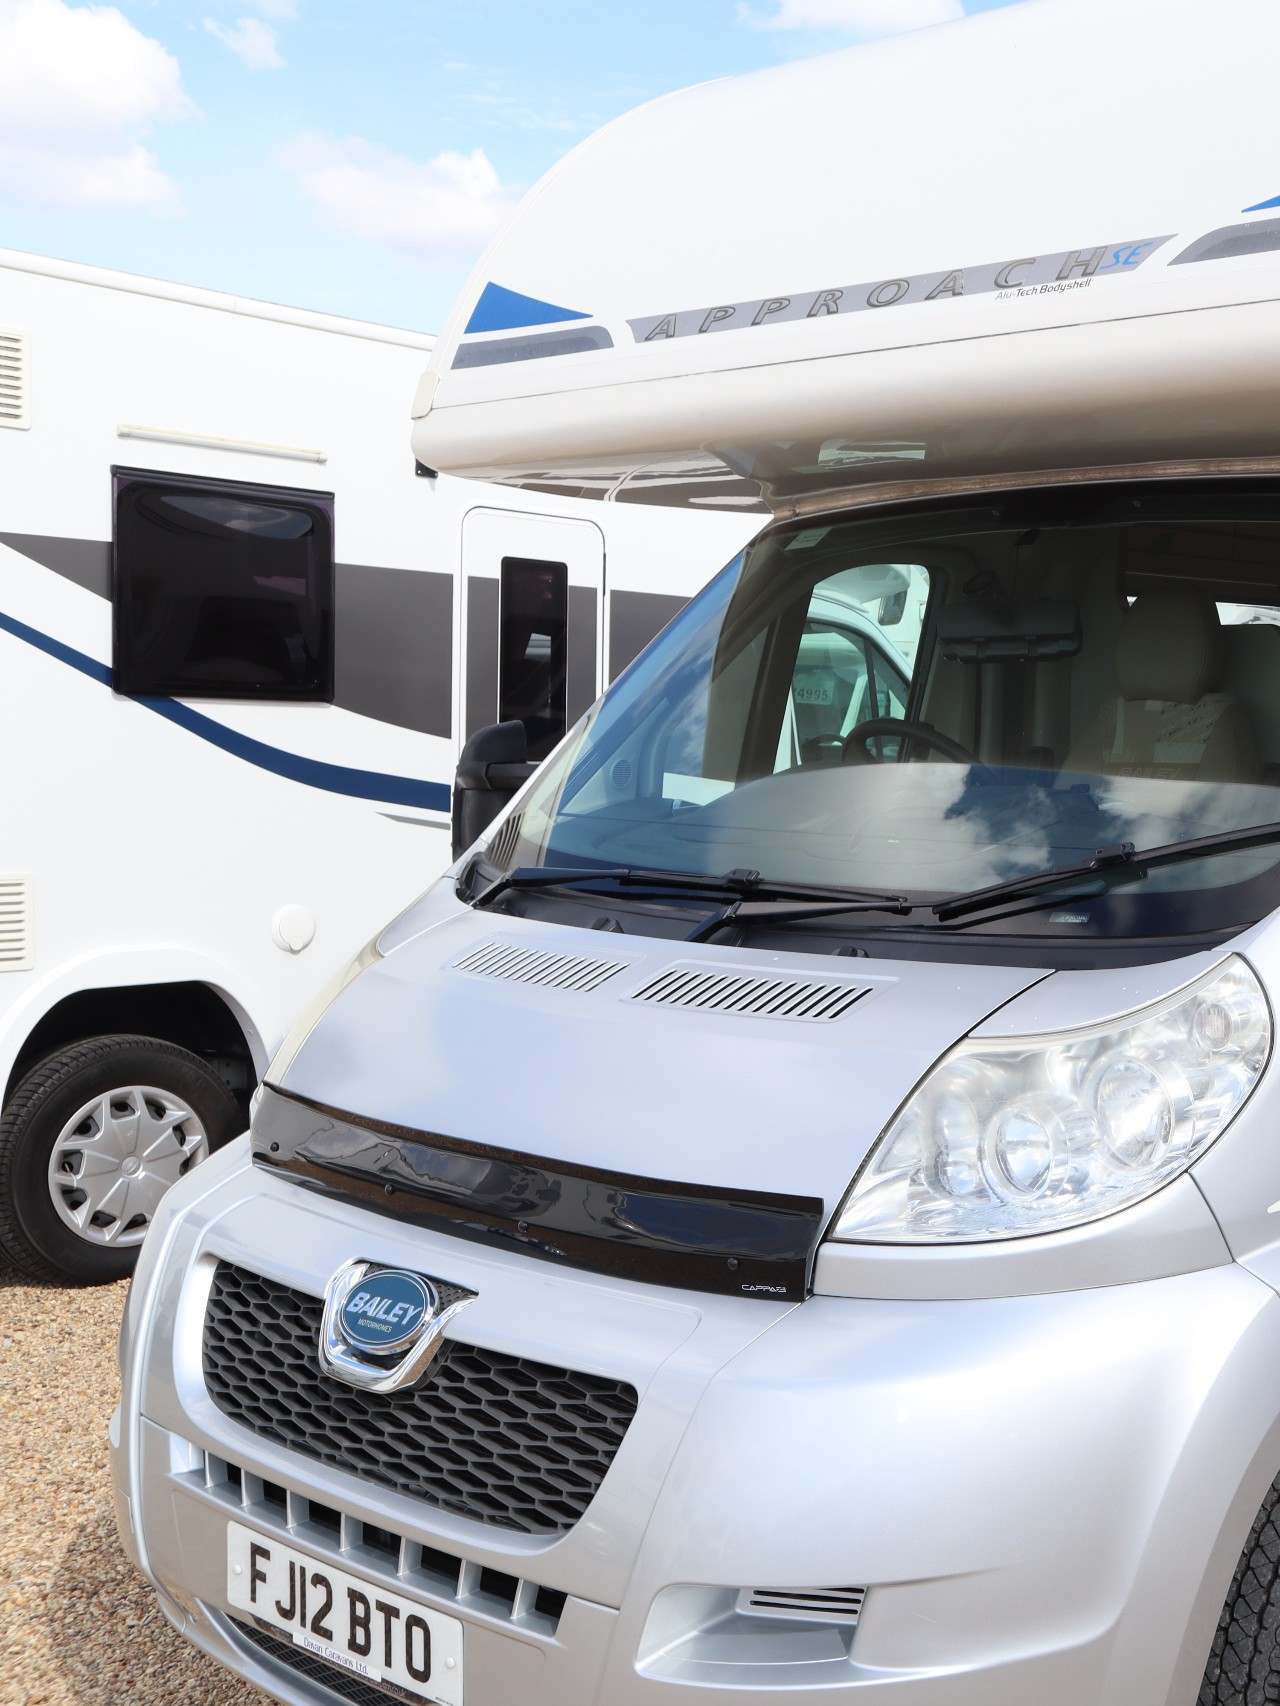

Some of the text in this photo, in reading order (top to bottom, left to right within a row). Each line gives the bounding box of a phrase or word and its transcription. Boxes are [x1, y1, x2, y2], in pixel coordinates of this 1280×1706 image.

[644, 242, 1153, 342] APPROACH SE
[995, 278, 1092, 301] Alu-Tech Bodyshell
[346, 1291, 422, 1325] BAILEY
[357, 1318, 392, 1333] MOTORHOMES
[250, 1541, 431, 1684] FJ12 BTO
[303, 1636, 369, 1675] Davan Caravans Ltd.
